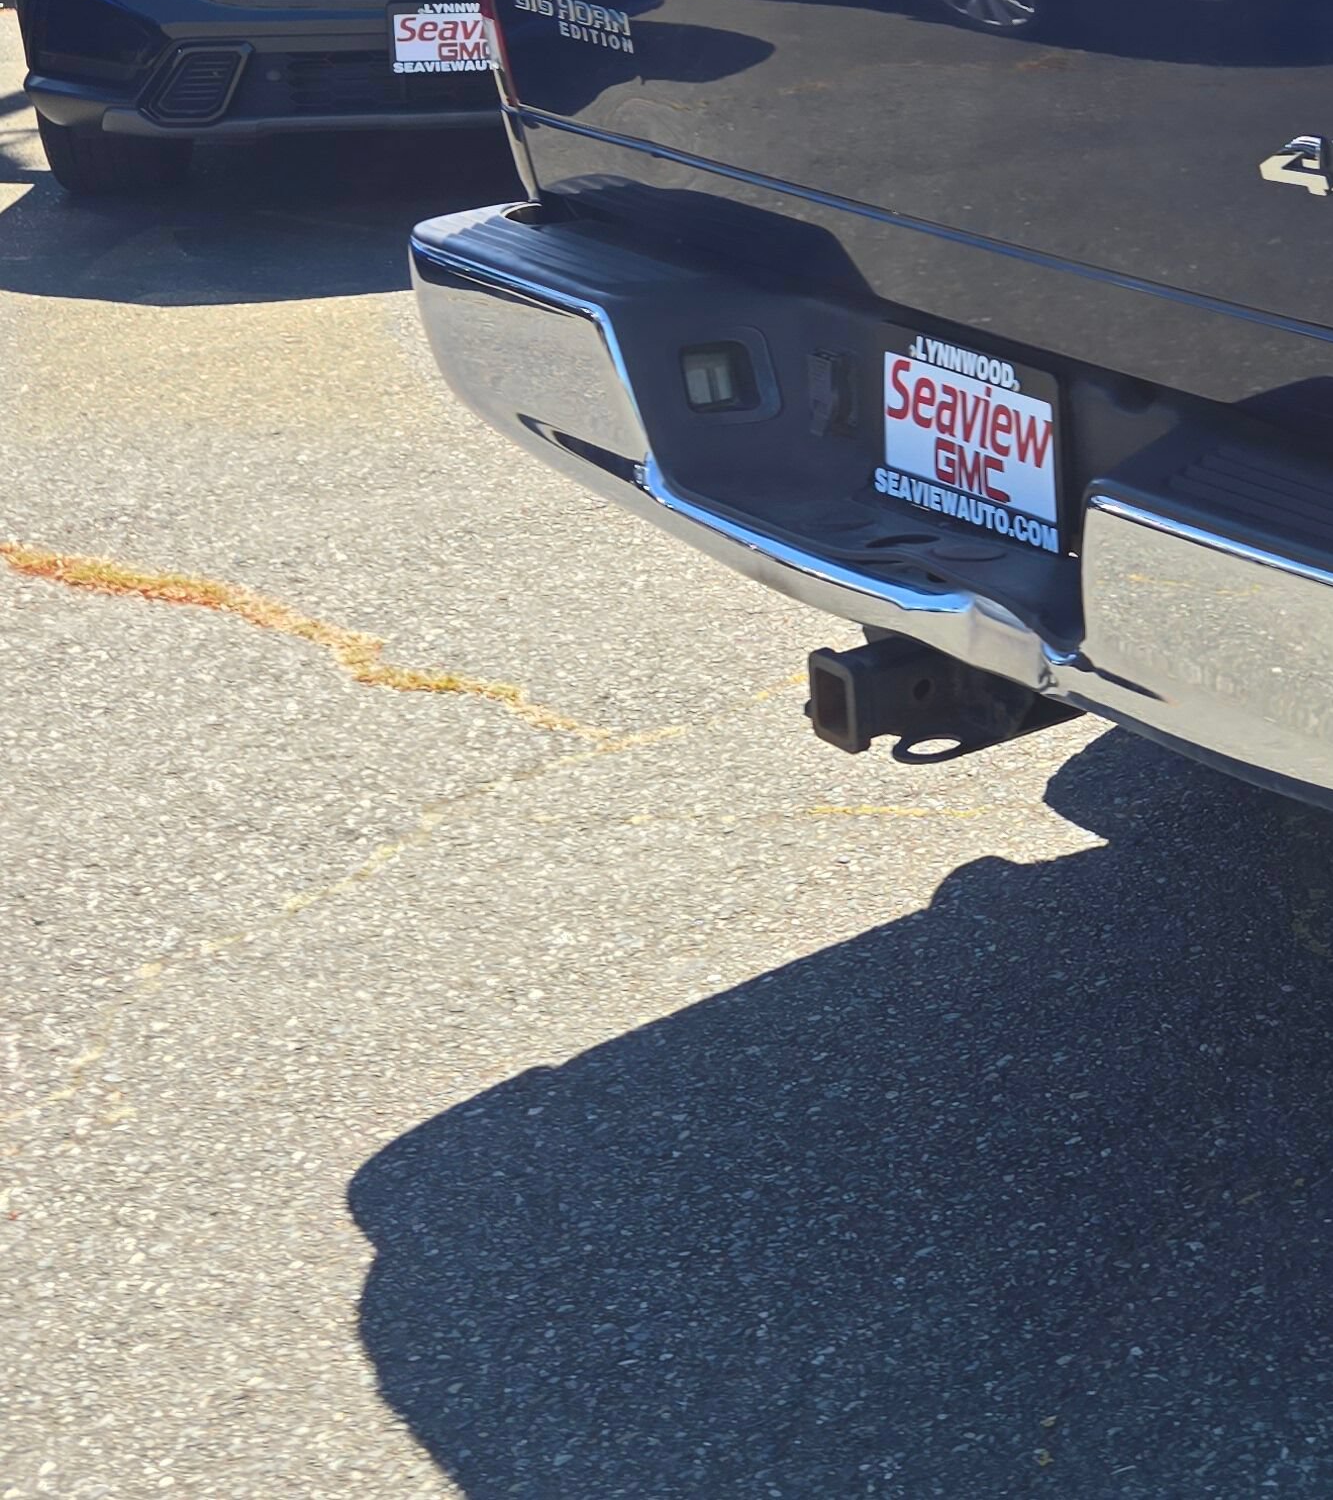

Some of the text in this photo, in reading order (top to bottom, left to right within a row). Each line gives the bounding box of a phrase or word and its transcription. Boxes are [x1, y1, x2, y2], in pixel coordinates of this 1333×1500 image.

[423, 3, 480, 14] LYNNW
[558, 21, 635, 53] EDITION
[393, 60, 497, 73] SEAVIEWAUT
[915, 335, 1015, 389] LYNNWOOD
[886, 359, 1053, 468] Seaview
[934, 437, 1011, 504] GMC
[873, 468, 1060, 554] SEAVIEWAUTO.COM
